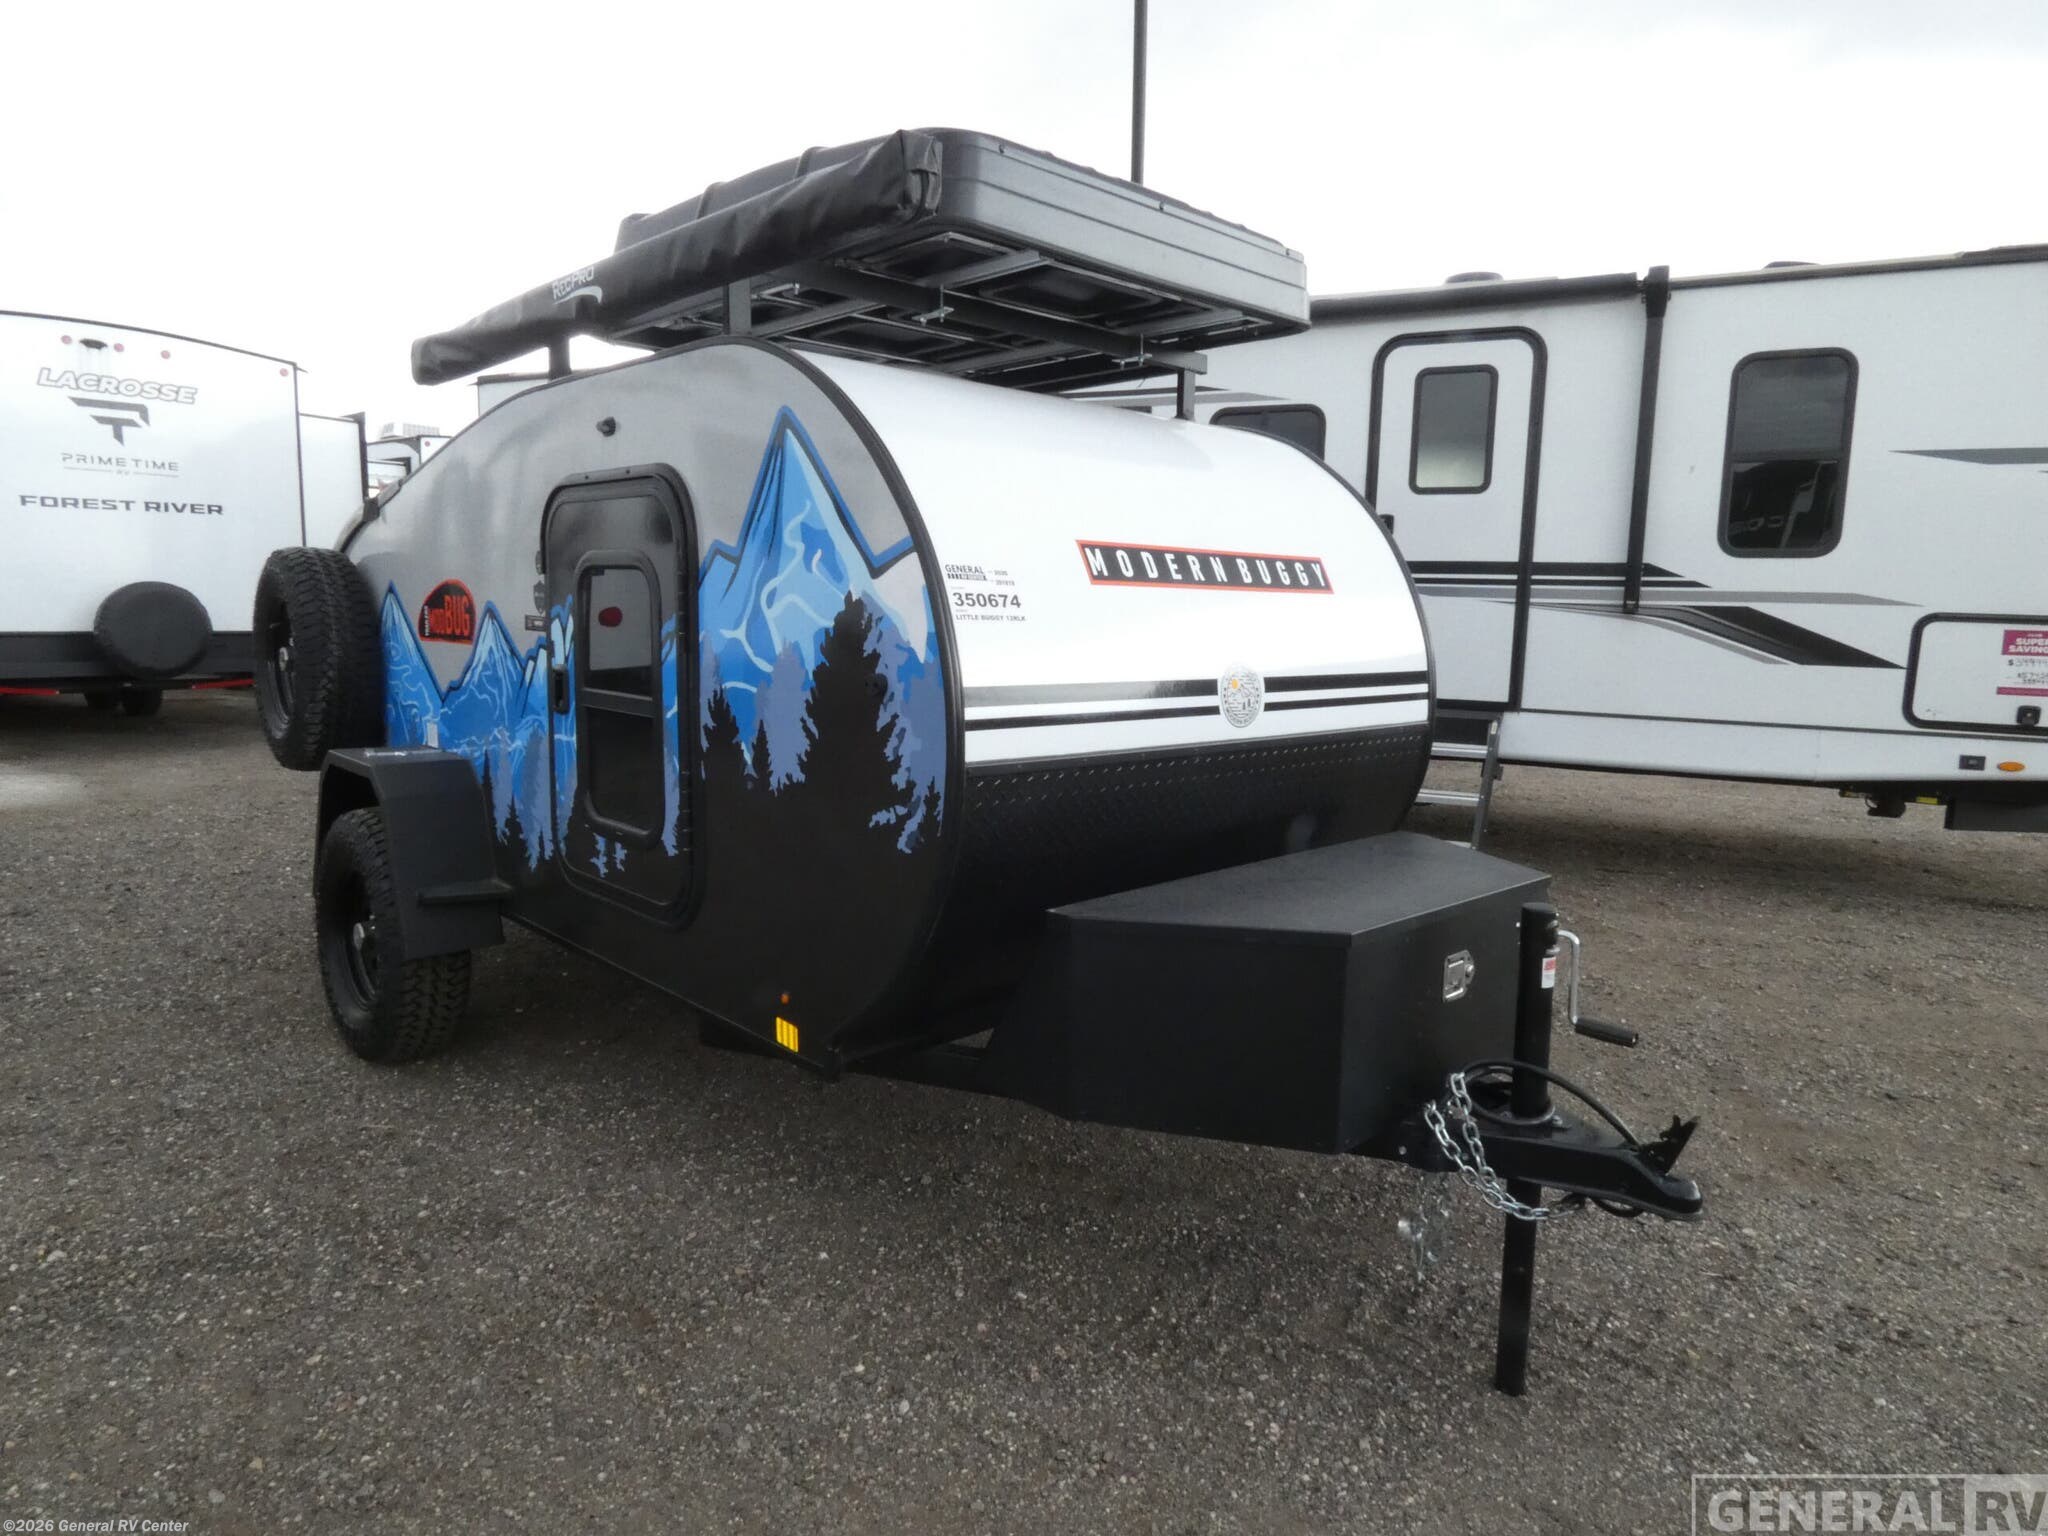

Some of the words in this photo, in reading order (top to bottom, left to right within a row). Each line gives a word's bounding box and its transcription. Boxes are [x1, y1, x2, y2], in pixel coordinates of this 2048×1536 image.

[37, 367, 198, 405] LACROSSE
[61, 452, 127, 468] PRIME
[132, 458, 179, 472] TIME
[19, 495, 136, 511] FOREST
[144, 500, 224, 515] RIVER
[945, 564, 984, 574] GENERAL
[953, 592, 1021, 608] 350674
